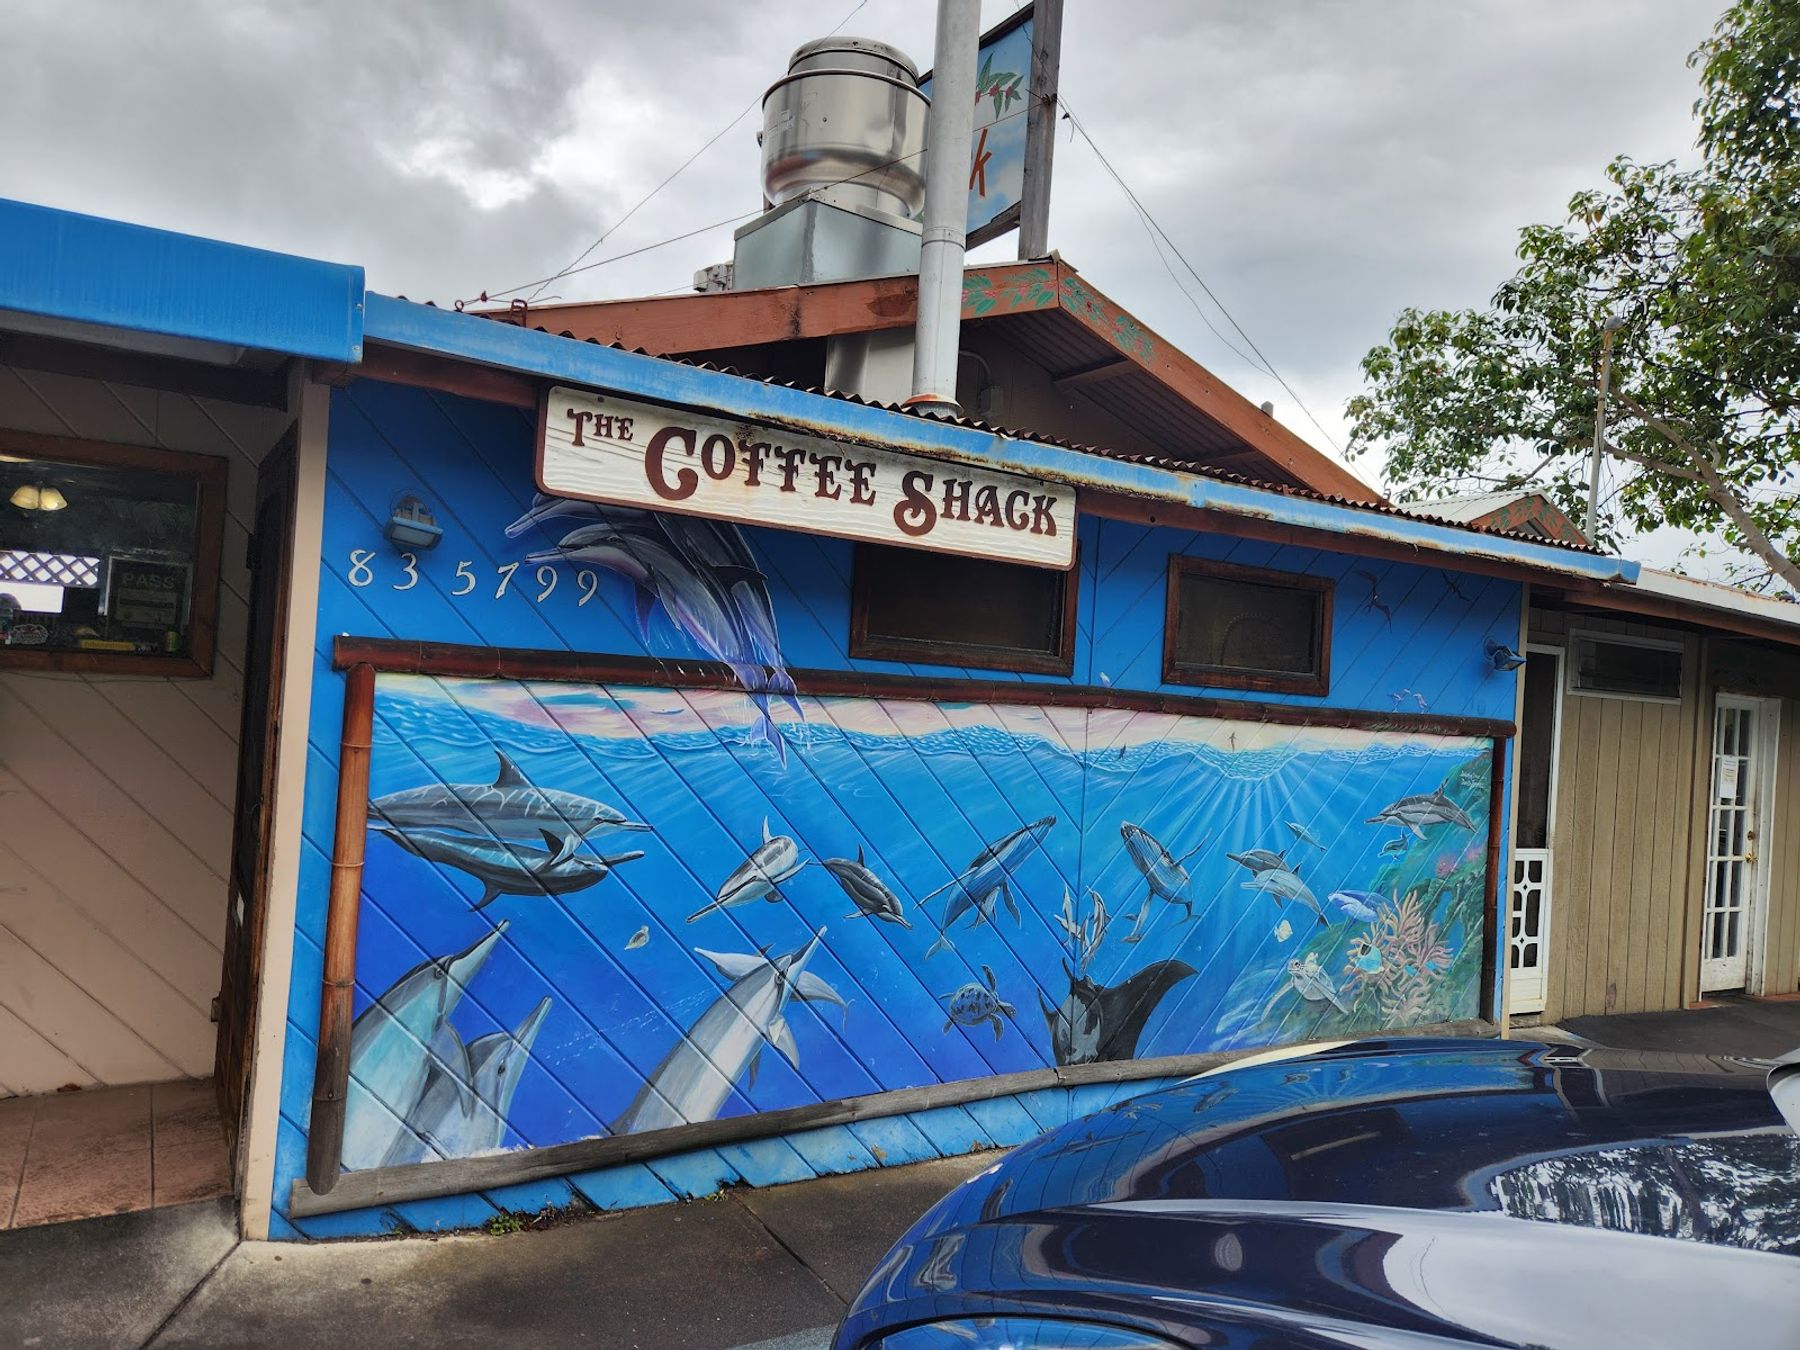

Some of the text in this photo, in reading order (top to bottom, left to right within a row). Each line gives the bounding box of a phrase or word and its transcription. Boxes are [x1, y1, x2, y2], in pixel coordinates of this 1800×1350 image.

[566, 407, 1059, 537] THE COFFEE SHACK
[121, 572, 176, 589] PASS
